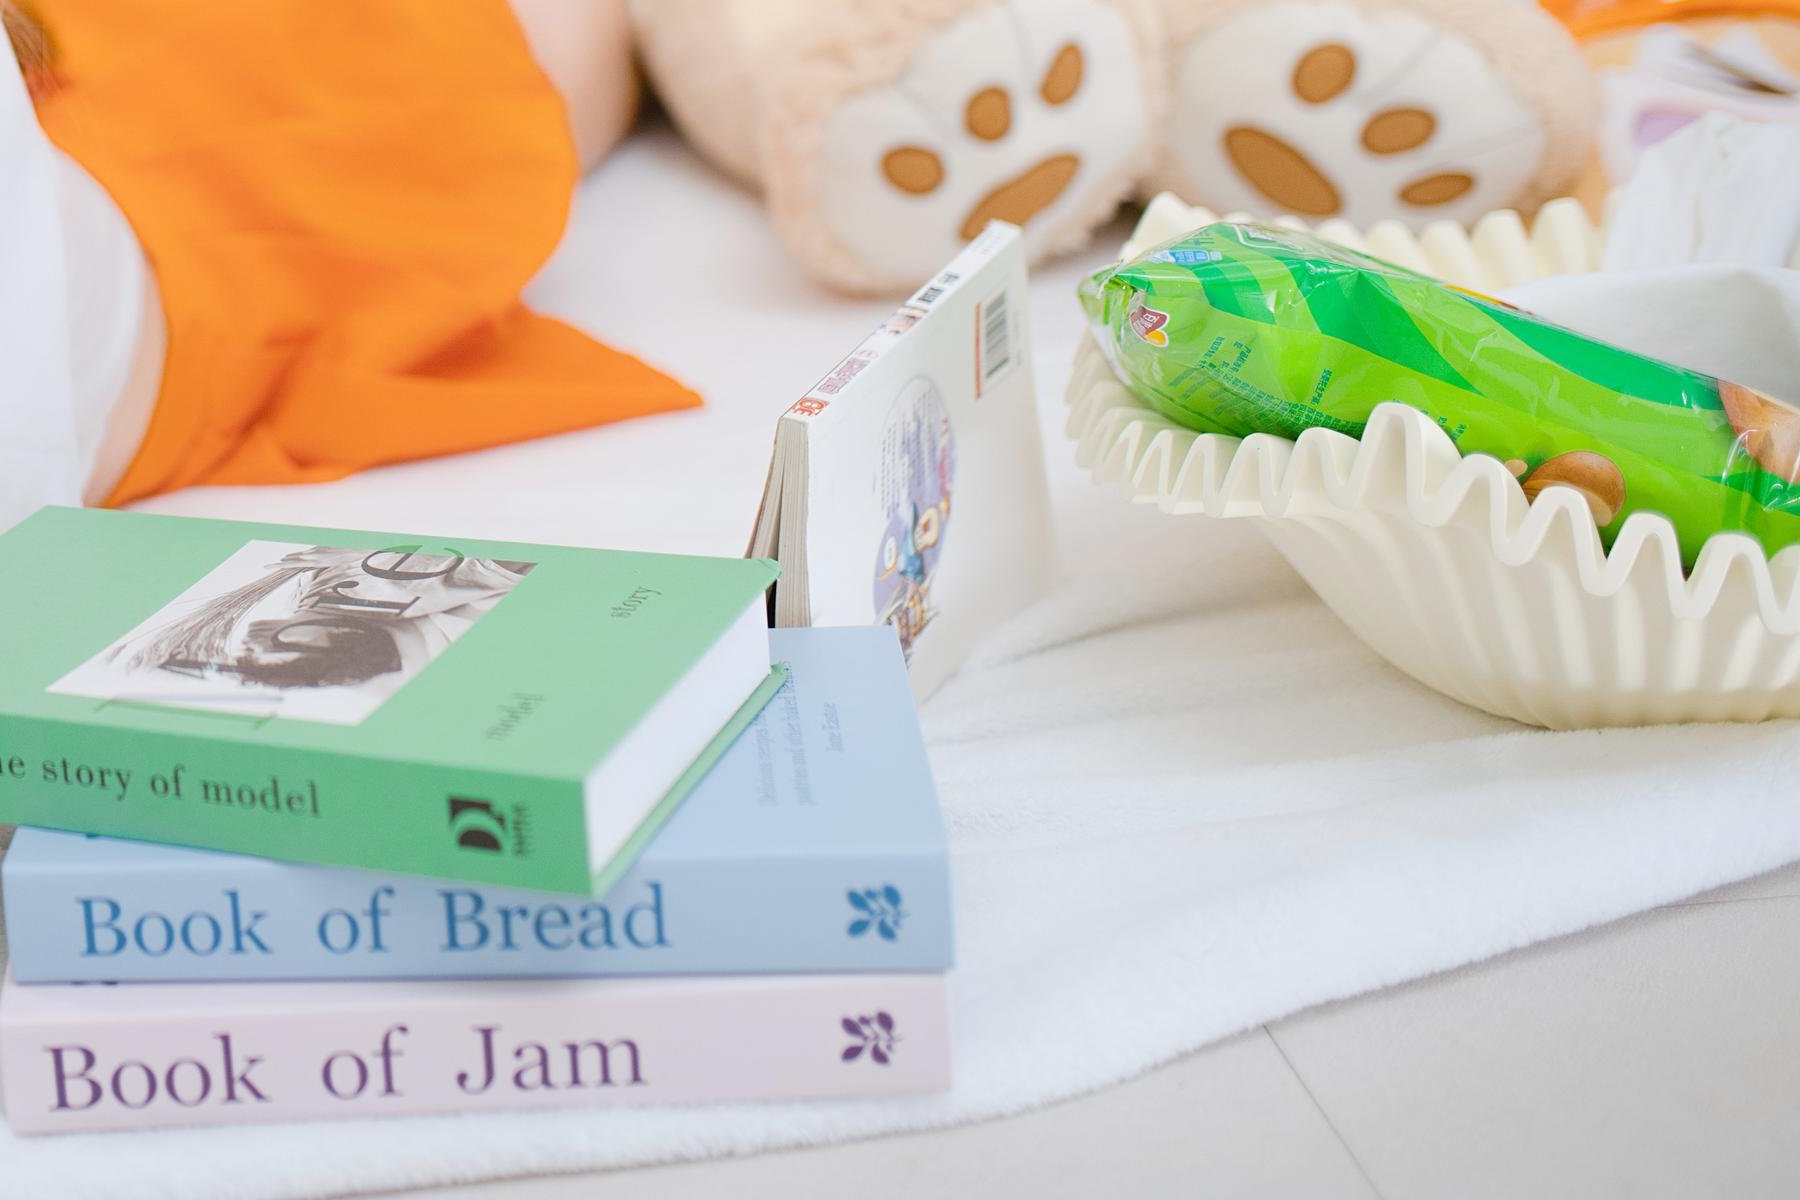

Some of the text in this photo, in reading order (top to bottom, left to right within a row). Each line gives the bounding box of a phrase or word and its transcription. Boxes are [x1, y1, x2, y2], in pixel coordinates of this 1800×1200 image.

[610, 586, 663, 619] story
[42, 757, 132, 801] story
[151, 763, 187, 799] of
[202, 775, 322, 818] model
[75, 879, 674, 958] Book of Bread
[44, 1022, 649, 1112] Book of Jam
